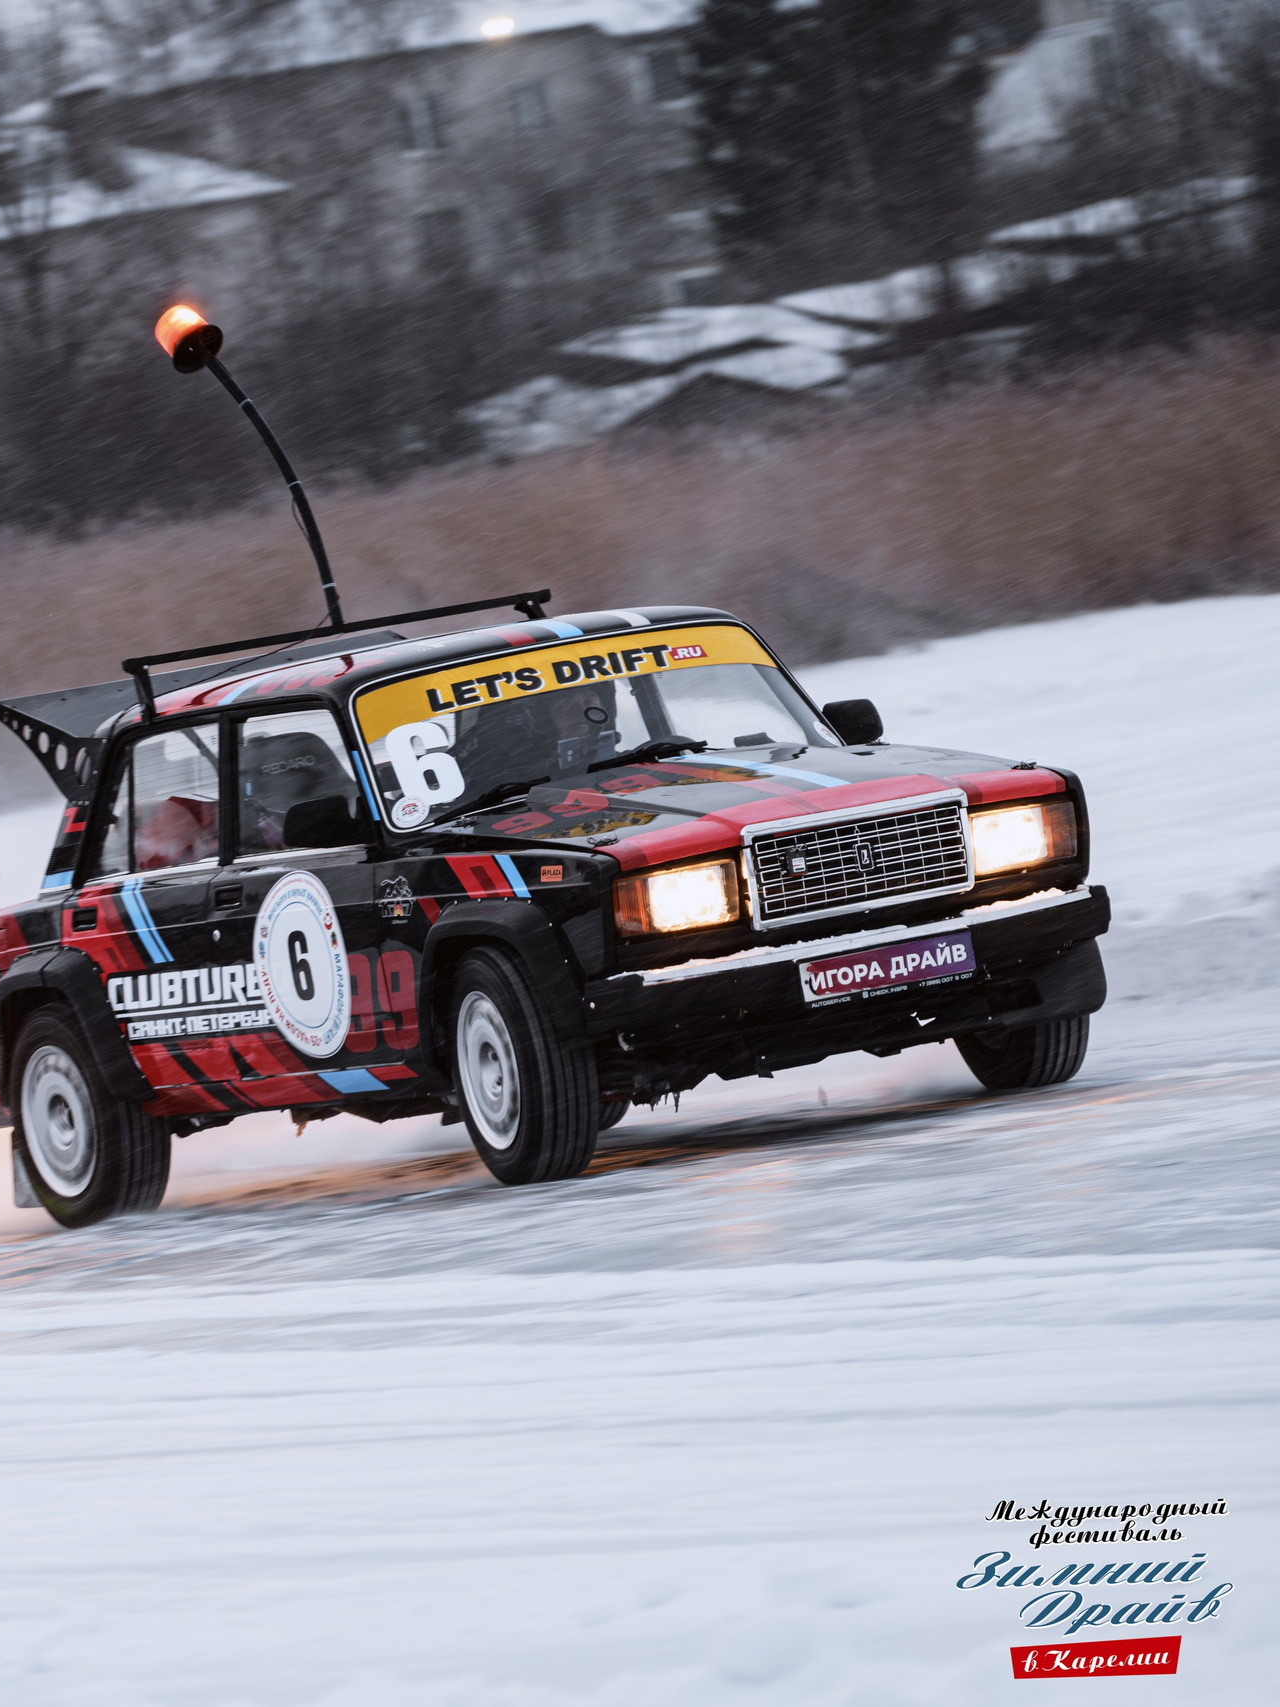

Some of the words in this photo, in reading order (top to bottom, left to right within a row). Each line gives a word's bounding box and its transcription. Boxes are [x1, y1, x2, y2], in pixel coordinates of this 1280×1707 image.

[426, 667, 545, 713] LET'S
[552, 644, 673, 687] DRIFT
[385, 722, 465, 806] 6
[107, 963, 263, 1011] CLUBTURB
[288, 930, 315, 1001] 6
[811, 961, 885, 991] ИГОРА
[890, 942, 968, 979] ДРАЙВ
[127, 1009, 274, 1039] САНКТ-ПЕТЕРБУР
[811, 996, 851, 1008] AUTOSERVICE
